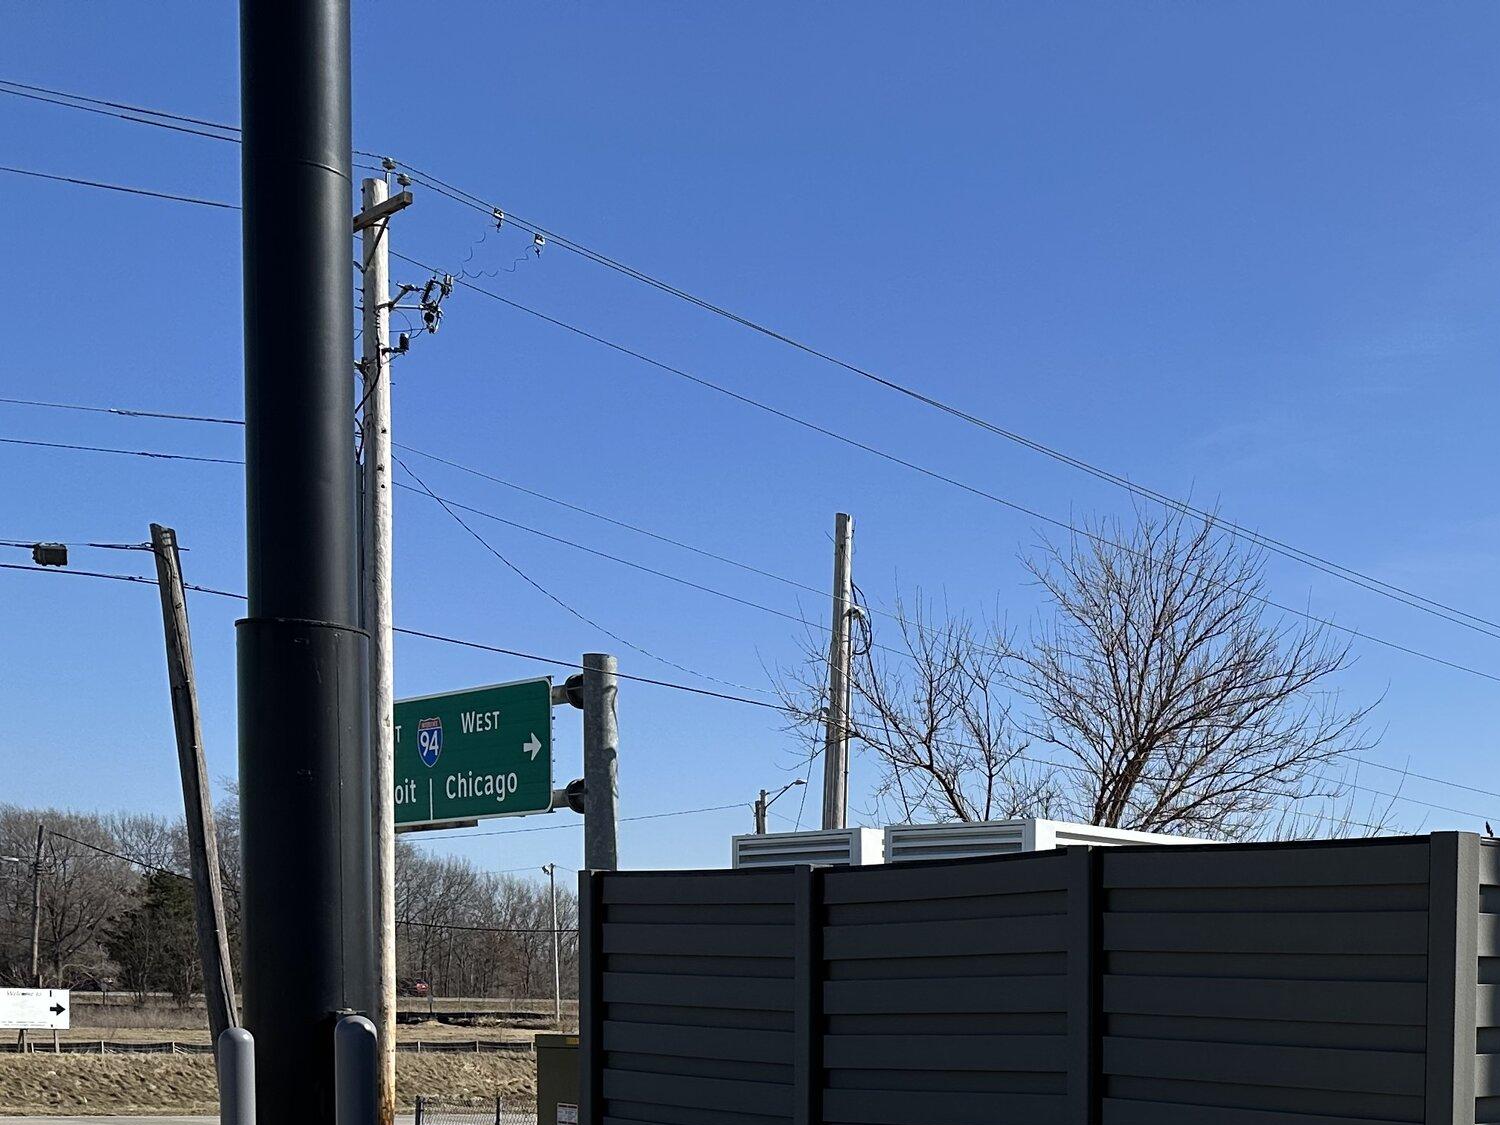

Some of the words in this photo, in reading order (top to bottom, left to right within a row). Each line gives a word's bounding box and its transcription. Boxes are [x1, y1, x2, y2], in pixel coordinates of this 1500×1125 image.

[461, 711, 500, 734] WEST
[420, 731, 439, 757] 94
[395, 778, 417, 804] oit
[446, 771, 518, 802] Chicago
